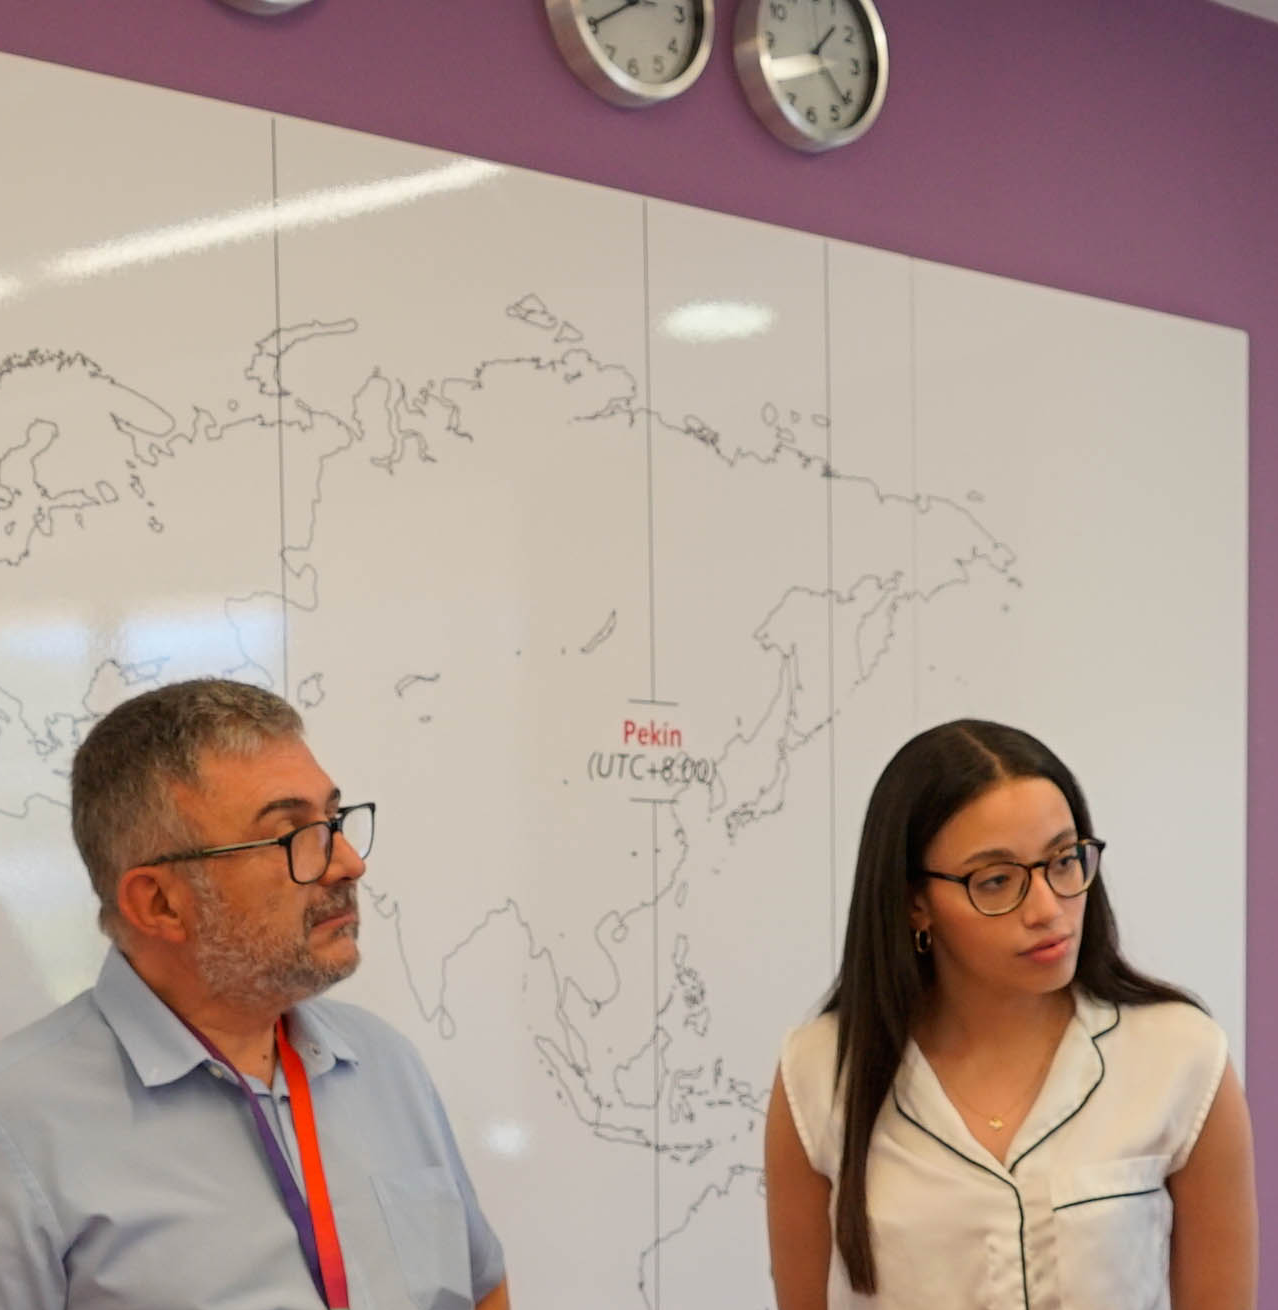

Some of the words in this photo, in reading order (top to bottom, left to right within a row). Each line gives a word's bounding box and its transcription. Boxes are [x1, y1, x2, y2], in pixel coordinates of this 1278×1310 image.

[675, 5, 685, 24] 3
[844, 25, 854, 43] 2
[605, 44, 616, 61] 7
[668, 37, 678, 54] 4
[628, 57, 640, 76] 6
[653, 55, 664, 74] 5
[806, 106, 817, 125] 6
[623, 719, 683, 748] Pekin
